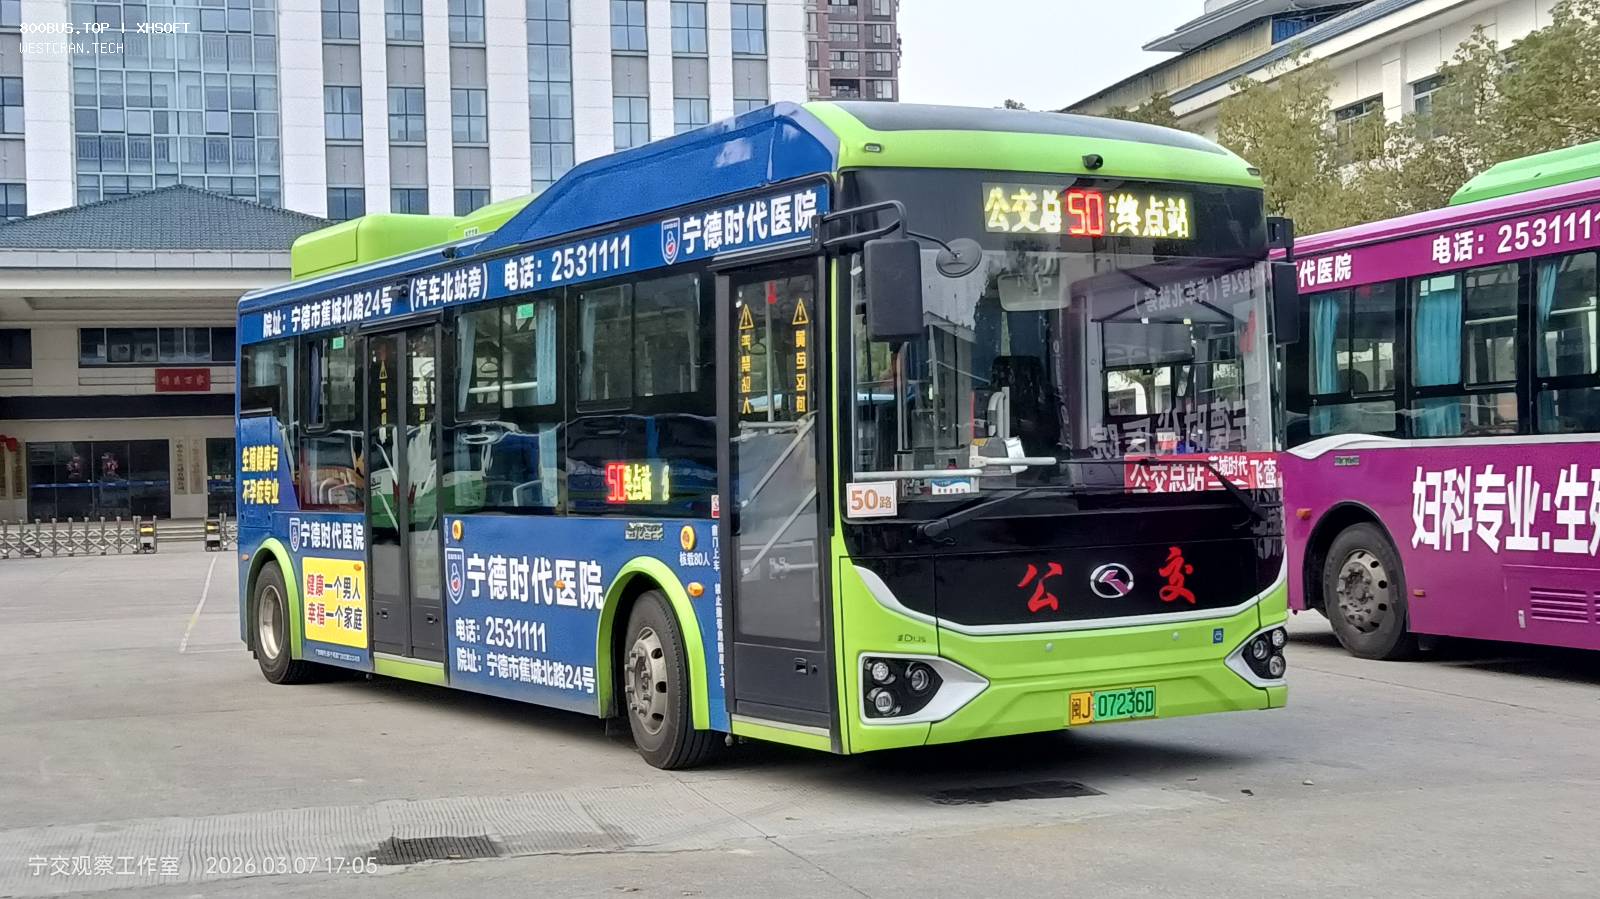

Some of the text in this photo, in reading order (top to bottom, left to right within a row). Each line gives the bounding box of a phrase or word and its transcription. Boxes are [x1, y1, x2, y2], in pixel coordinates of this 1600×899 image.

[683, 190, 817, 254] 宁德时代医院
[1296, 252, 1352, 288] 代医院
[242, 445, 279, 472] 生殖健康与
[242, 478, 279, 505] 不孕症专业
[1129, 463, 1205, 493] 公交总站
[851, 488, 892, 511] 50路
[300, 520, 365, 550] 宁德时代医院
[307, 573, 361, 600] 健康一个男人
[466, 553, 603, 610] 宁德时代医院
[1017, 546, 1196, 613] 公 交
[308, 602, 363, 631] 幸福一个家庭
[1098, 690, 1154, 717] 07236D
